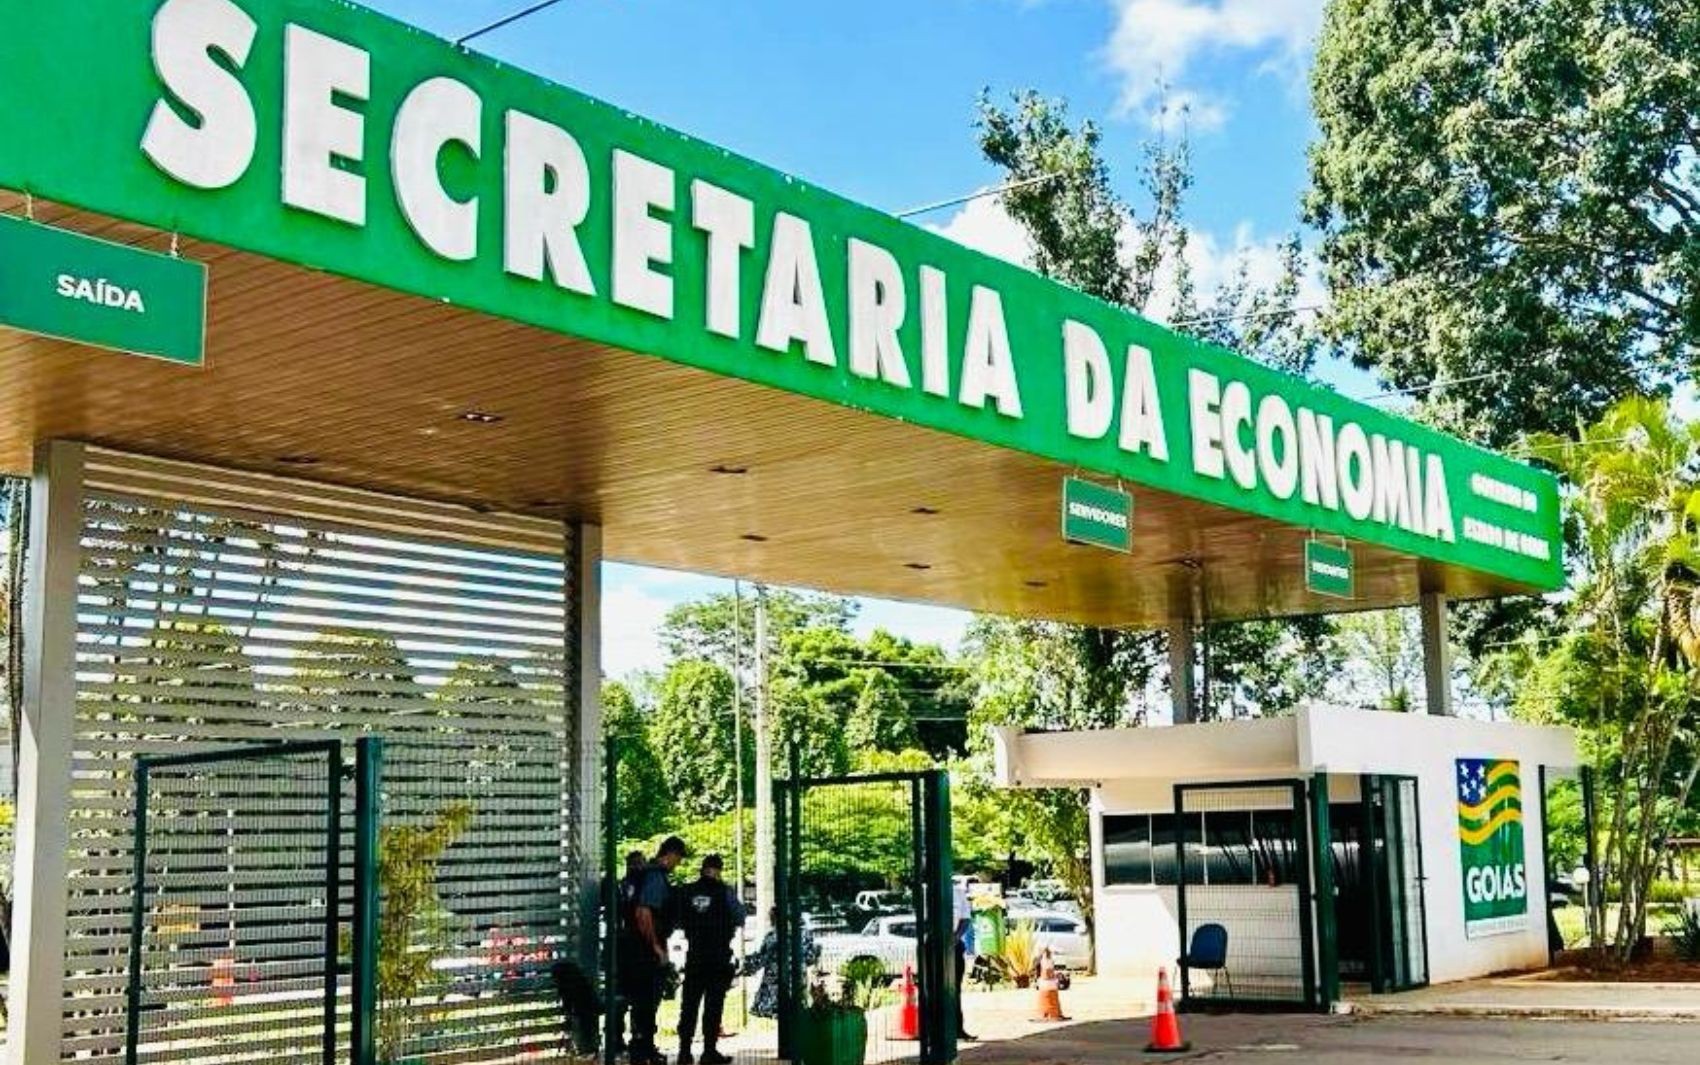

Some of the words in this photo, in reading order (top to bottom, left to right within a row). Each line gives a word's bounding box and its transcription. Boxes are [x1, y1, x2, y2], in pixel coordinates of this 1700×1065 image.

[57, 274, 145, 313] SAÍDA
[140, 0, 1023, 419] SECRETARIA
[1063, 318, 1169, 462] DA
[1188, 368, 1456, 543] ECONOMIA
